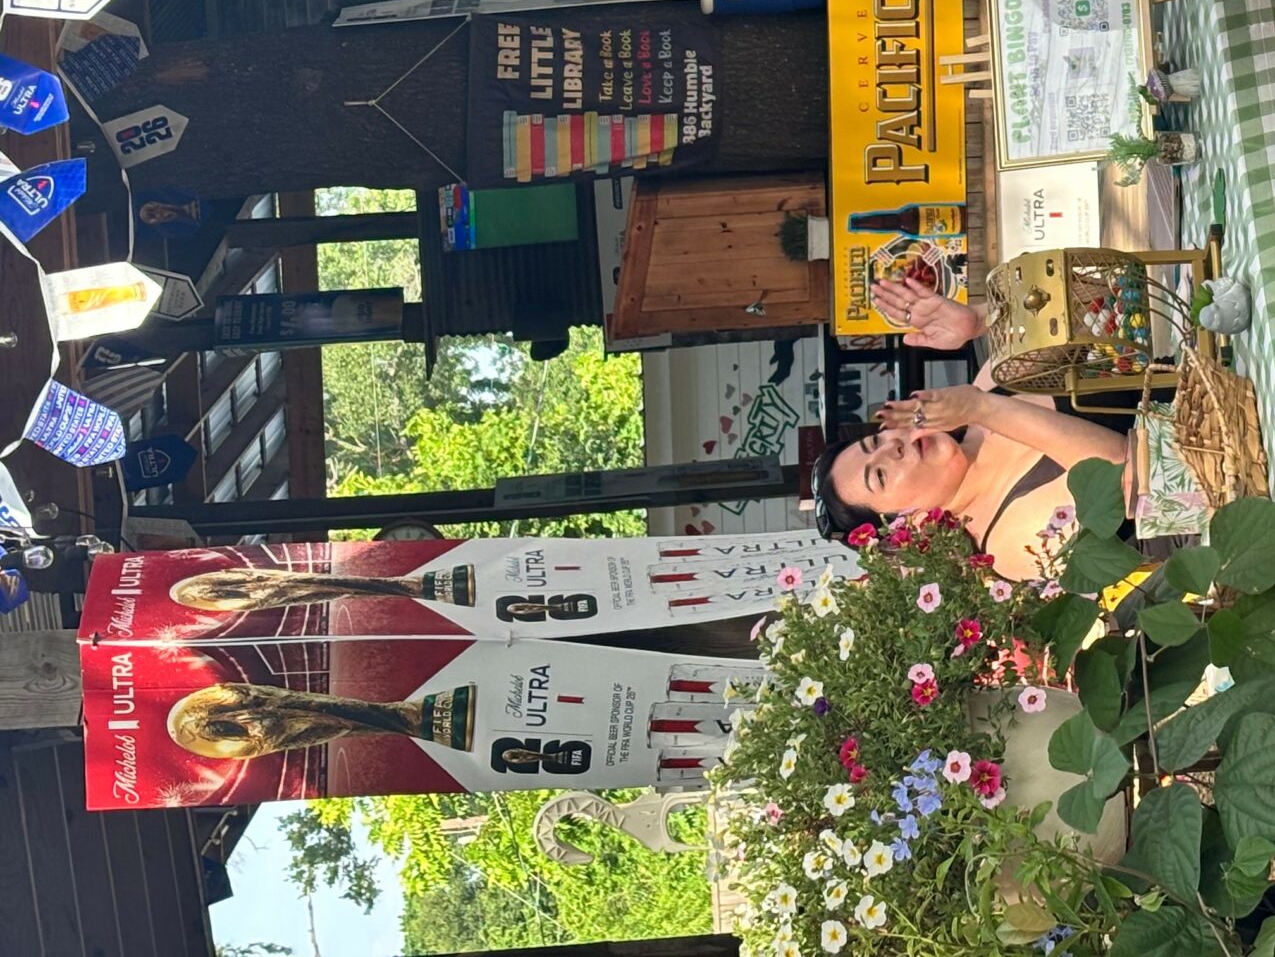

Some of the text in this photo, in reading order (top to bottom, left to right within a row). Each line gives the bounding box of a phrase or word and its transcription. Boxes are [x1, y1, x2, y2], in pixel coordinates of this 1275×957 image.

[497, 22, 521, 80] FREE
[530, 25, 554, 100] LITTLE
[561, 27, 584, 109] LIBRARY
[599, 29, 613, 58] Book
[638, 29, 651, 59] Book
[657, 28, 675, 104] Keep a Book
[1027, 31, 1039, 52] Pay
[599, 71, 614, 102] Take
[619, 28, 634, 111] Leave a Book
[638, 70, 652, 104] Love
[683, 50, 698, 114] Humble
[13, 84, 38, 115] ULTRA
[698, 65, 717, 138] Backyard
[1008, 71, 1031, 144] PLANT
[115, 125, 147, 155] 20
[141, 116, 174, 145] 26
[17, 178, 49, 209] ULTRA
[1033, 188, 1045, 241] ULTRA
[846, 246, 869, 321] PACIFICO
[146, 446, 159, 477] ULTRA
[524, 549, 547, 588] ULTRA
[107, 555, 145, 637] Michelob ULTRA
[432, 696, 443, 733] FIFA
[505, 673, 524, 718] Michelob
[525, 664, 551, 727] ULTRA
[111, 652, 141, 804] Michelob ULTRA
[605, 682, 623, 766] OFFICIAL BEER SPONSOR OF
[619, 700, 634, 763] THE FIFA WORLD CUP
[570, 749, 582, 766] FIFA
